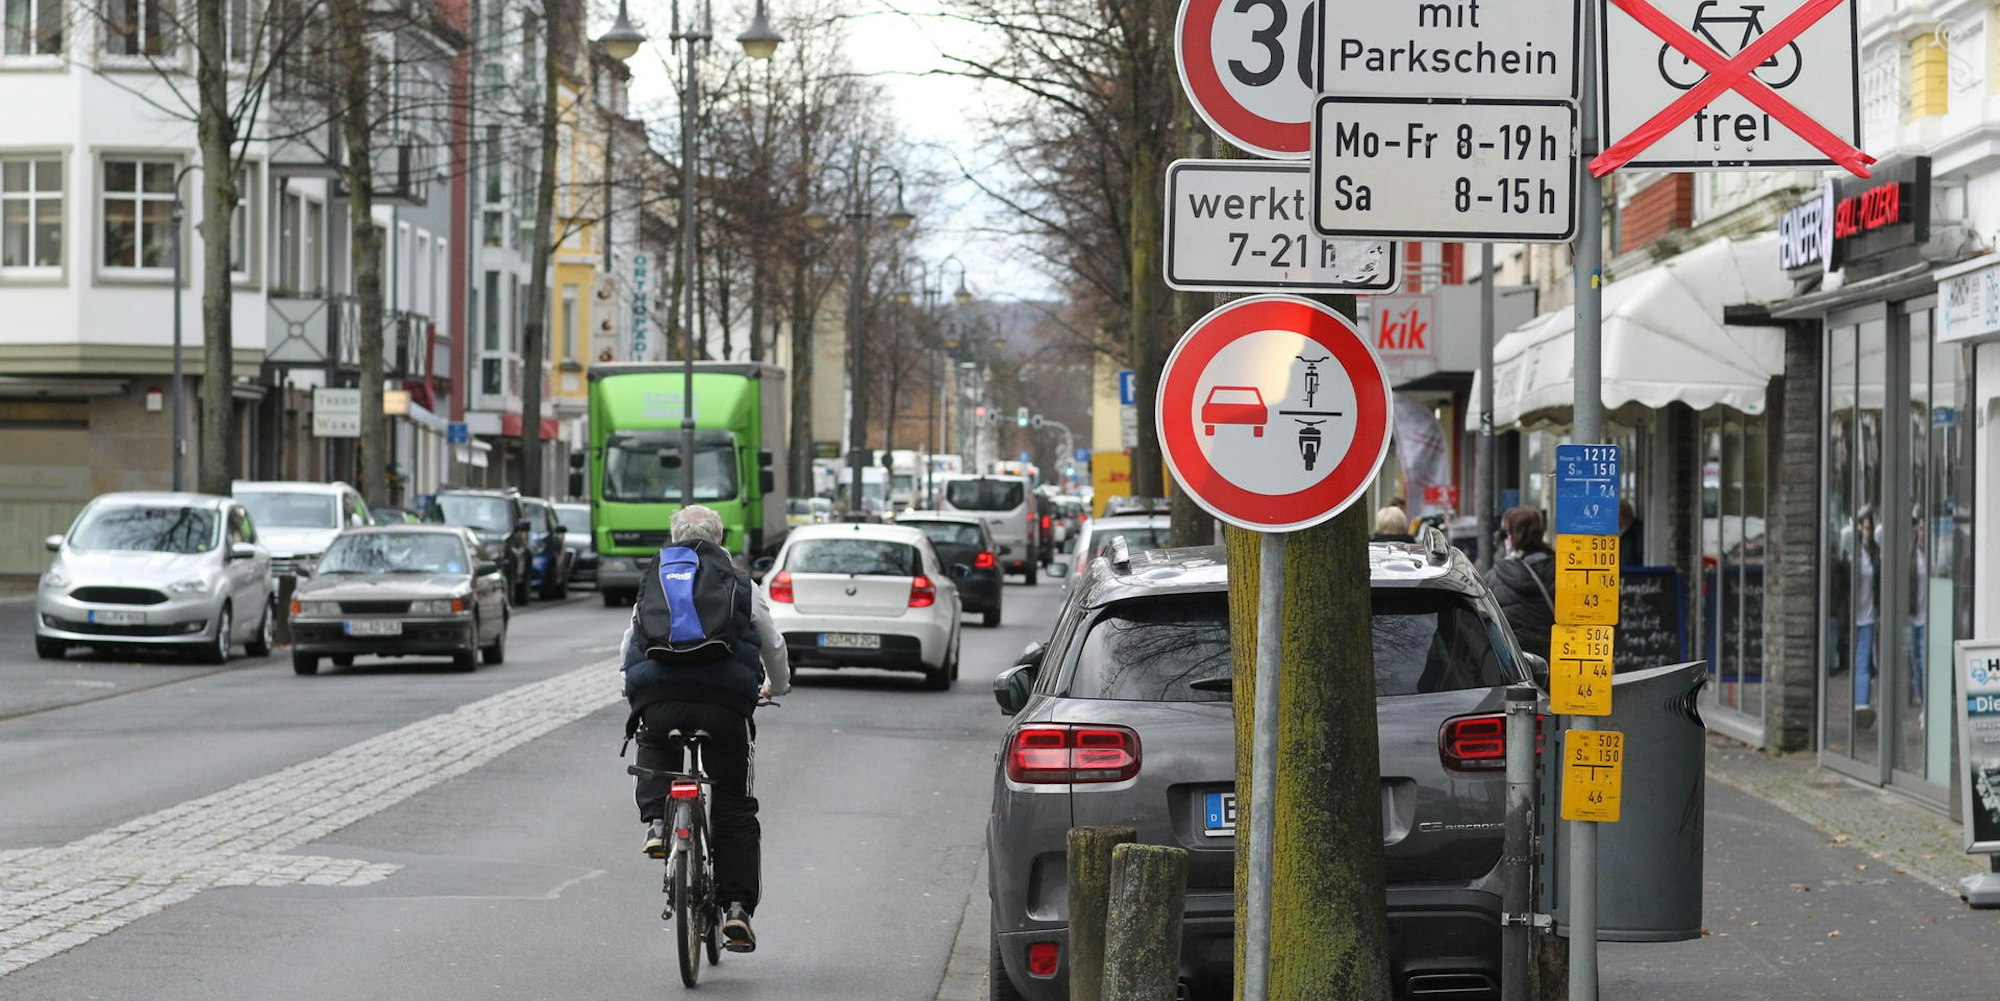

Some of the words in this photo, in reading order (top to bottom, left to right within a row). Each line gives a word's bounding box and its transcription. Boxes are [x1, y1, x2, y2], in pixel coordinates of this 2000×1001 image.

[1418, 0, 1479, 28] mit
[1228, 0, 1313, 88] 3
[1340, 38, 1557, 75] Parkschein
[1694, 105, 1770, 142] frei
[1540, 125, 1556, 161] h
[1188, 186, 1309, 221] werkt
[1334, 174, 1372, 212] Sa
[1538, 178, 1555, 214] h
[1377, 304, 1429, 350] kik
[1584, 448, 1616, 461] 1212
[1593, 463, 1616, 476] 150
[1592, 538, 1616, 551] 503
[1593, 553, 1616, 565] 100
[1587, 628, 1609, 641] 504
[1588, 643, 1609, 656] 150
[1599, 735, 1621, 748] 502
[1599, 749, 1619, 762] 150
